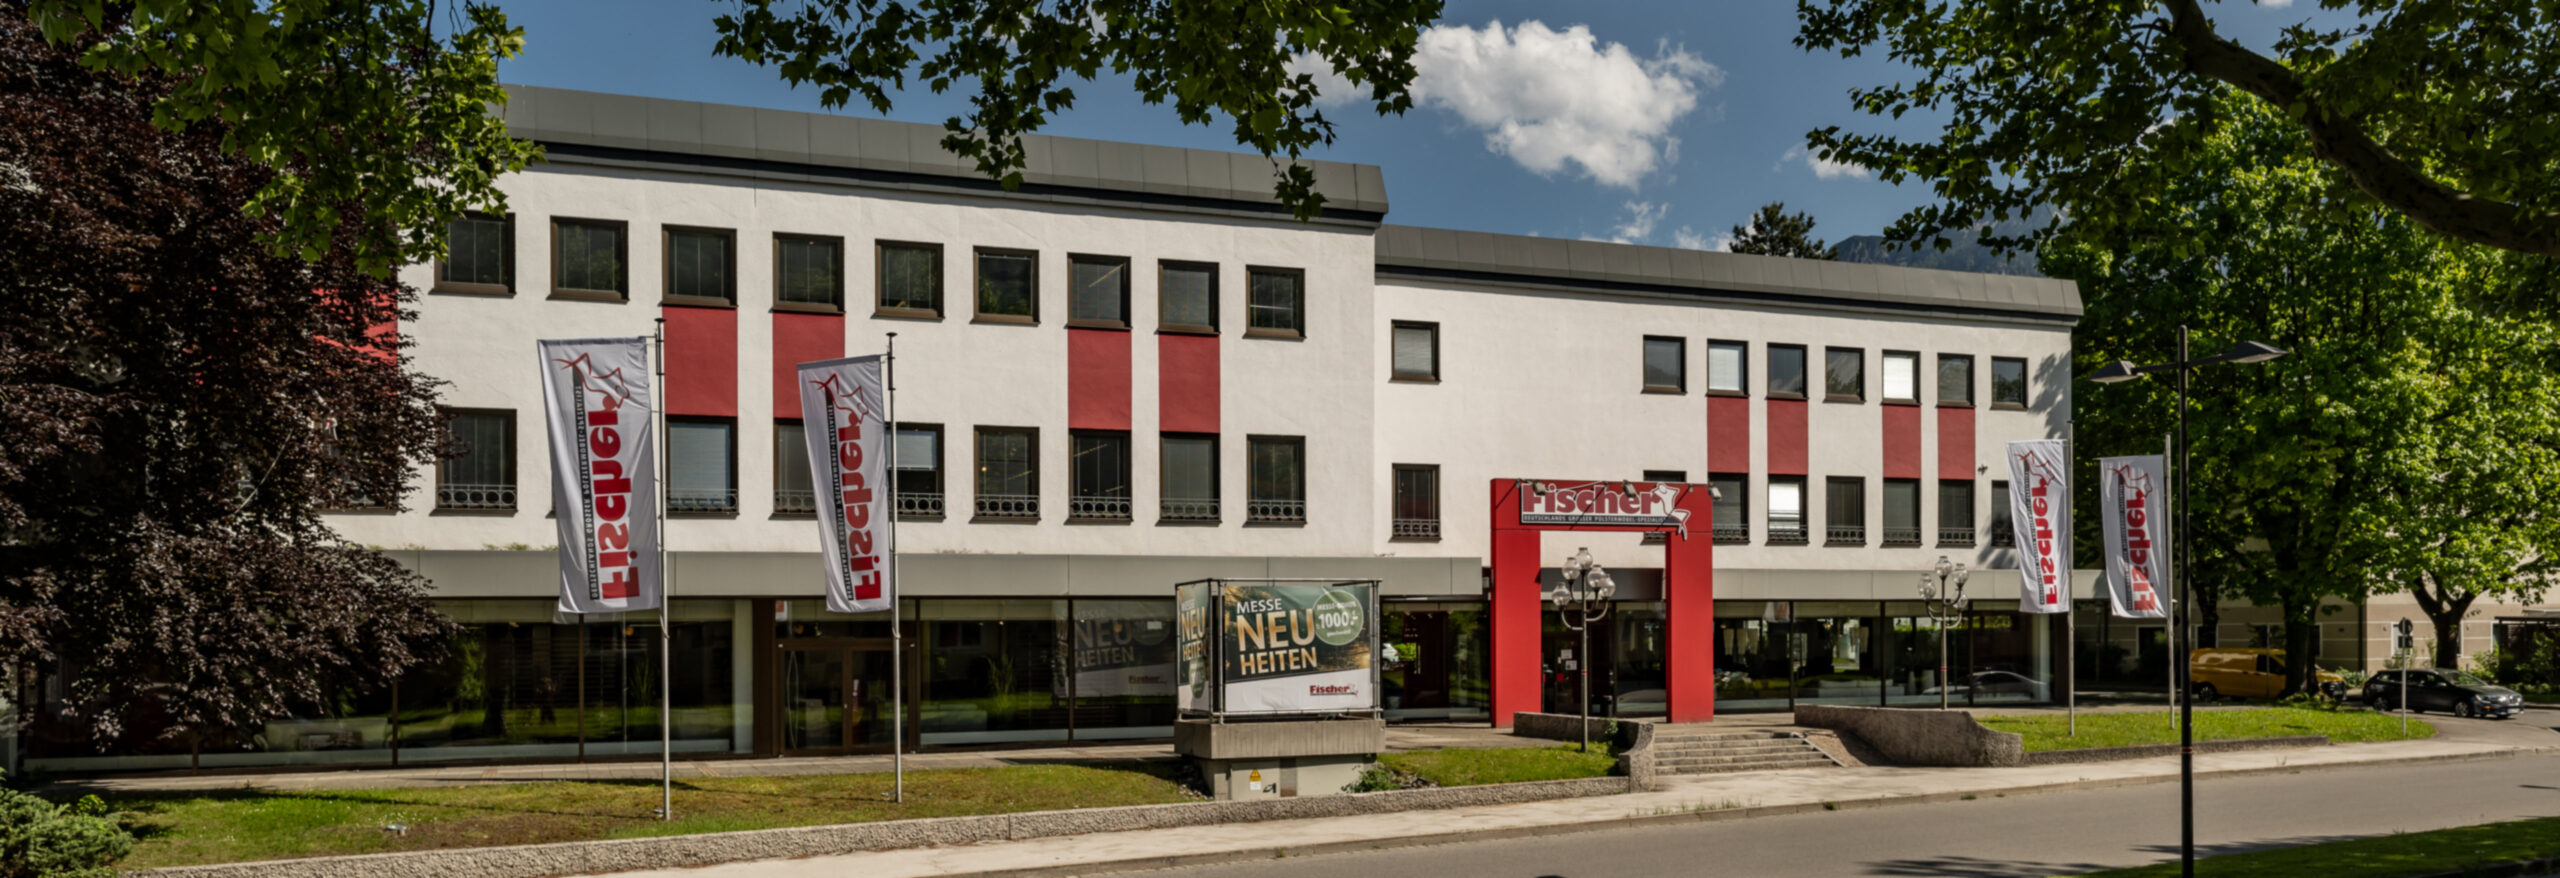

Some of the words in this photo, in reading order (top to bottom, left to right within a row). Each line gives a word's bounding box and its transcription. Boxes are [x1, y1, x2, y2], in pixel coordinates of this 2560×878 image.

[1522, 484, 1661, 515] Fischer
[1237, 598, 1282, 614] MESSE
[1181, 606, 1206, 642] NEU
[1237, 608, 1316, 652] NEU
[1240, 646, 1317, 676] HEITEN
[1309, 684, 1350, 694] Fischer
